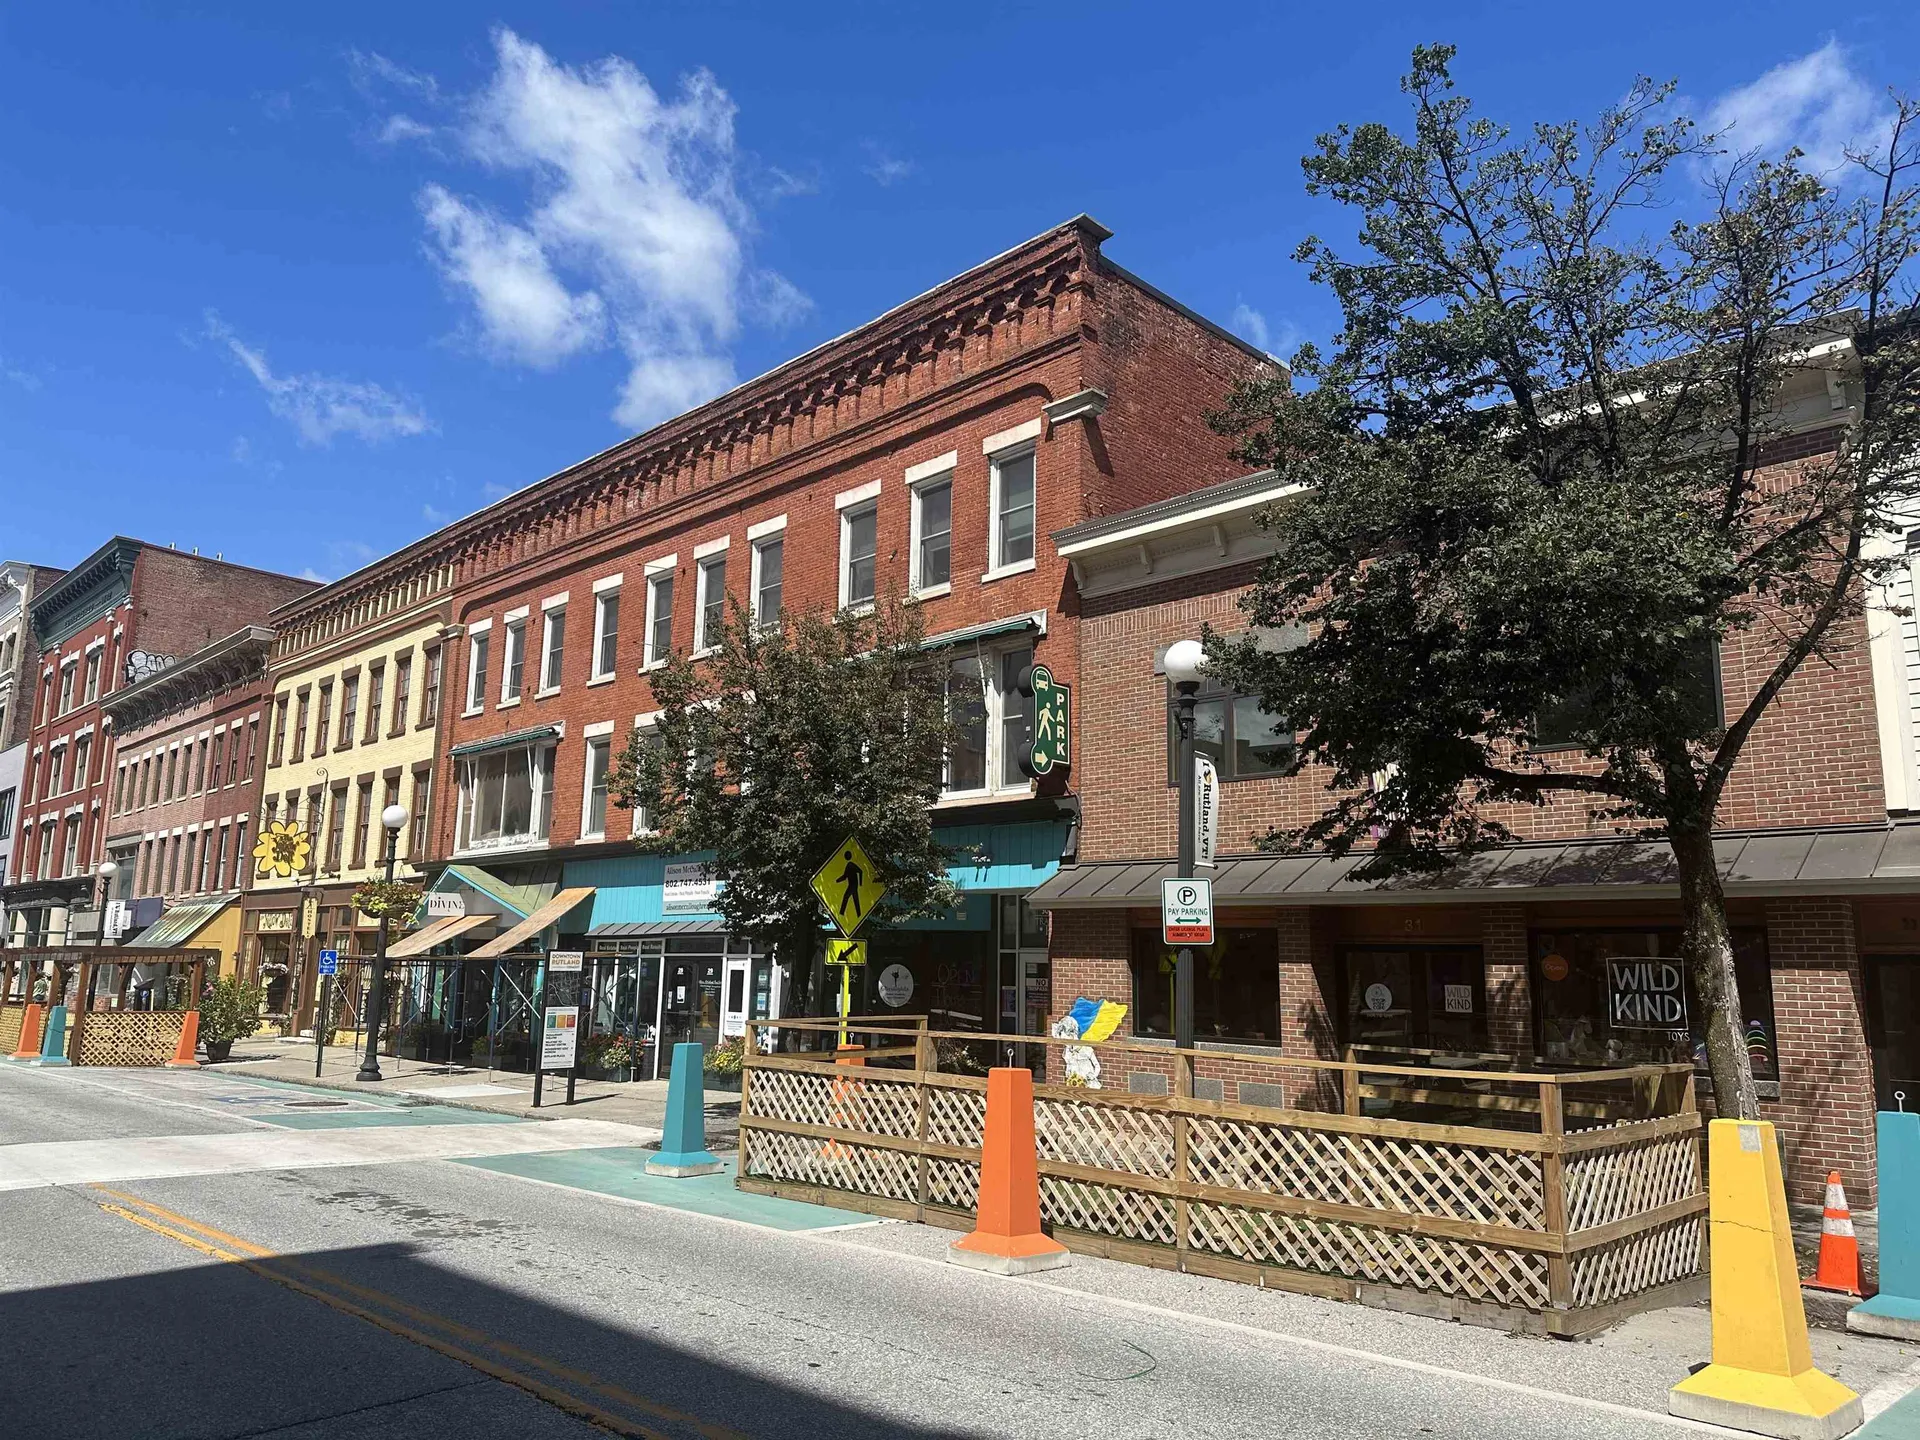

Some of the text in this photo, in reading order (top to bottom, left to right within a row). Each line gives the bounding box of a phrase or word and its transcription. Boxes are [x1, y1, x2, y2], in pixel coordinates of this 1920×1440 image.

[1056, 692, 1066, 756] PARK
[1183, 889, 1193, 903] P
[1168, 907, 1209, 916] PAY PARKING
[1612, 963, 1680, 992] WILD
[1446, 987, 1471, 998] WILD
[1446, 998, 1471, 1010] KIND
[1615, 993, 1682, 1022] KIND
[1666, 1031, 1691, 1041] TOYS
